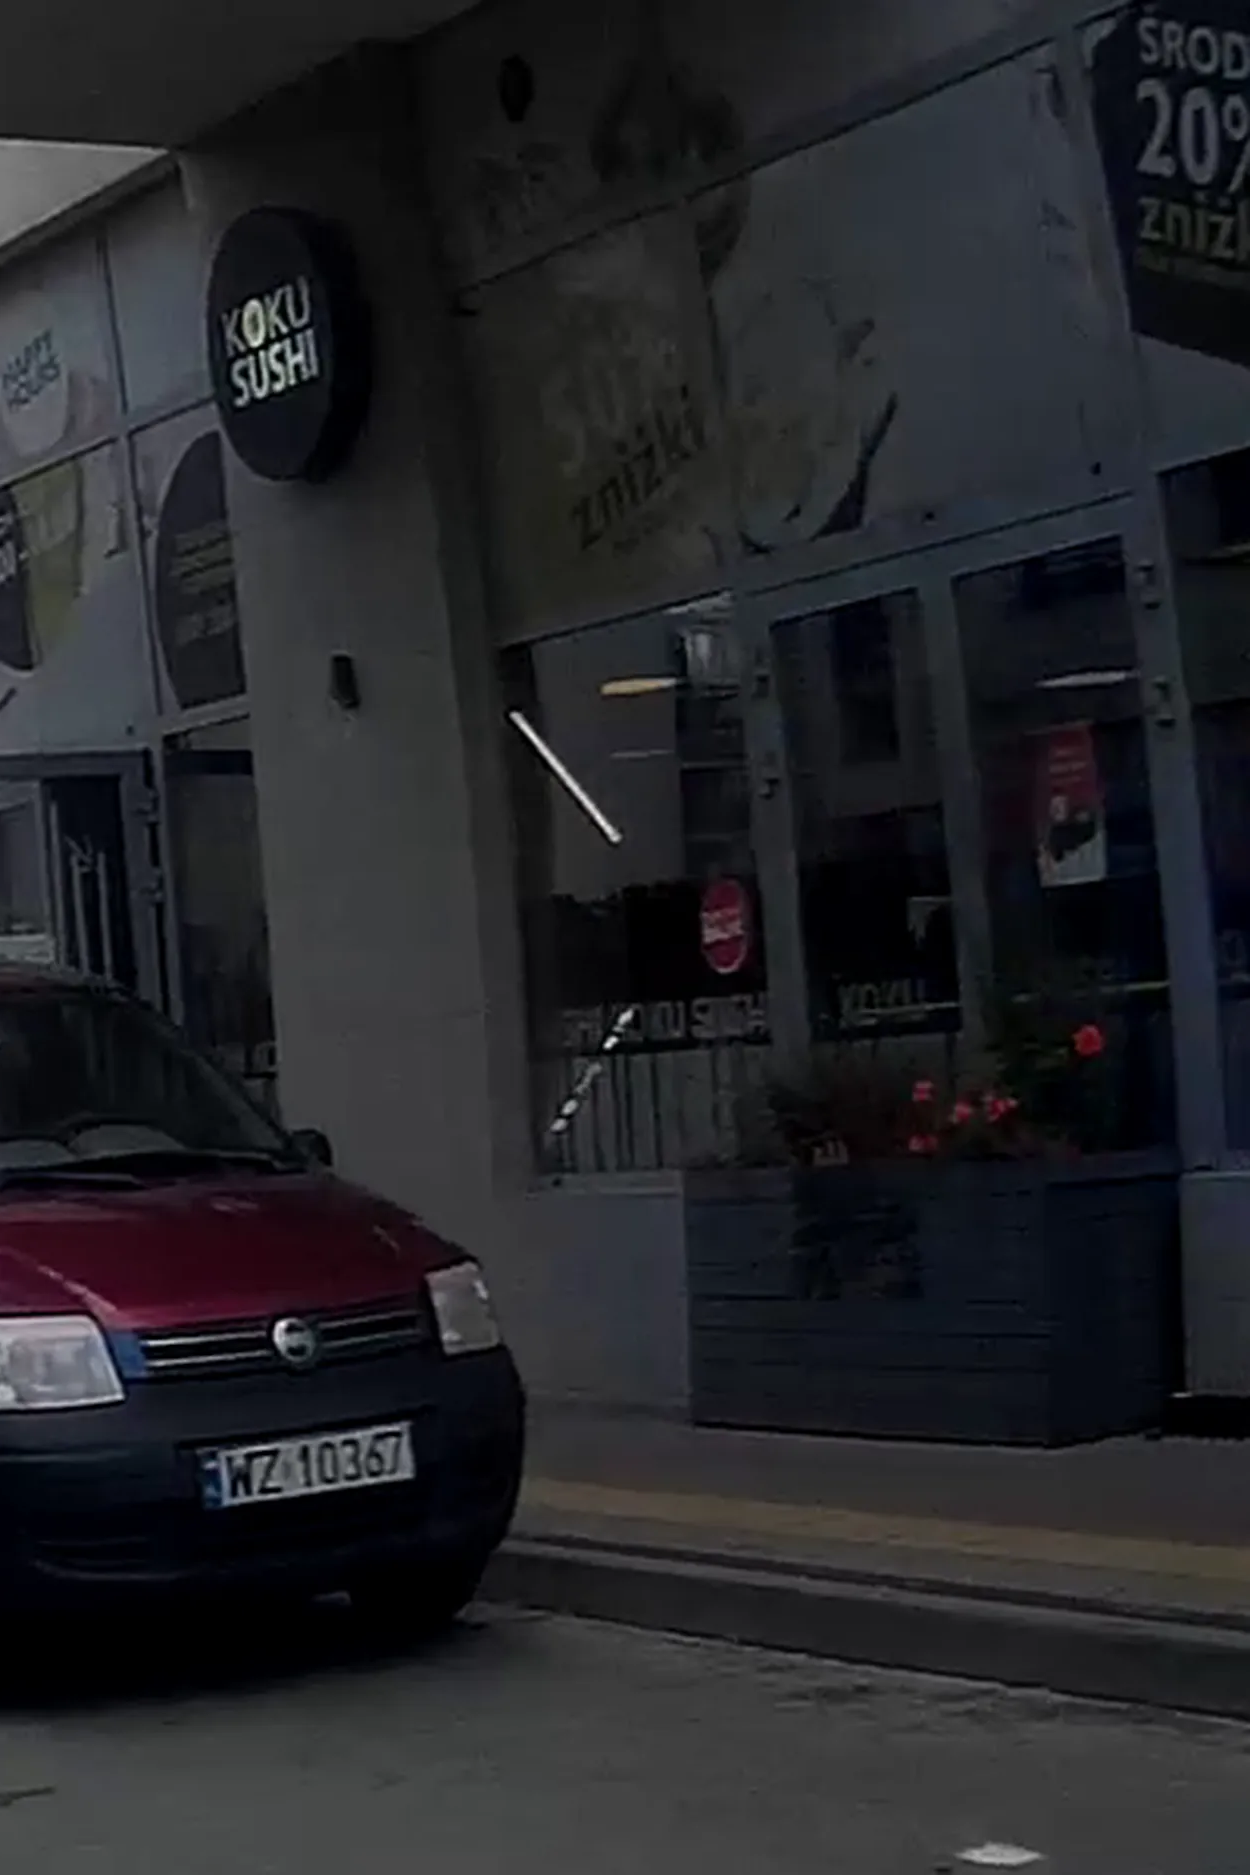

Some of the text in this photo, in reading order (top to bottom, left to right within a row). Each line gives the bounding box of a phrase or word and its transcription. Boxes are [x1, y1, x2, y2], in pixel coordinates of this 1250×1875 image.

[220, 275, 310, 357] KOKU
[229, 328, 319, 408] SUSHI
[226, 1450, 282, 1497] WZ
[298, 1431, 401, 1487] 10367
